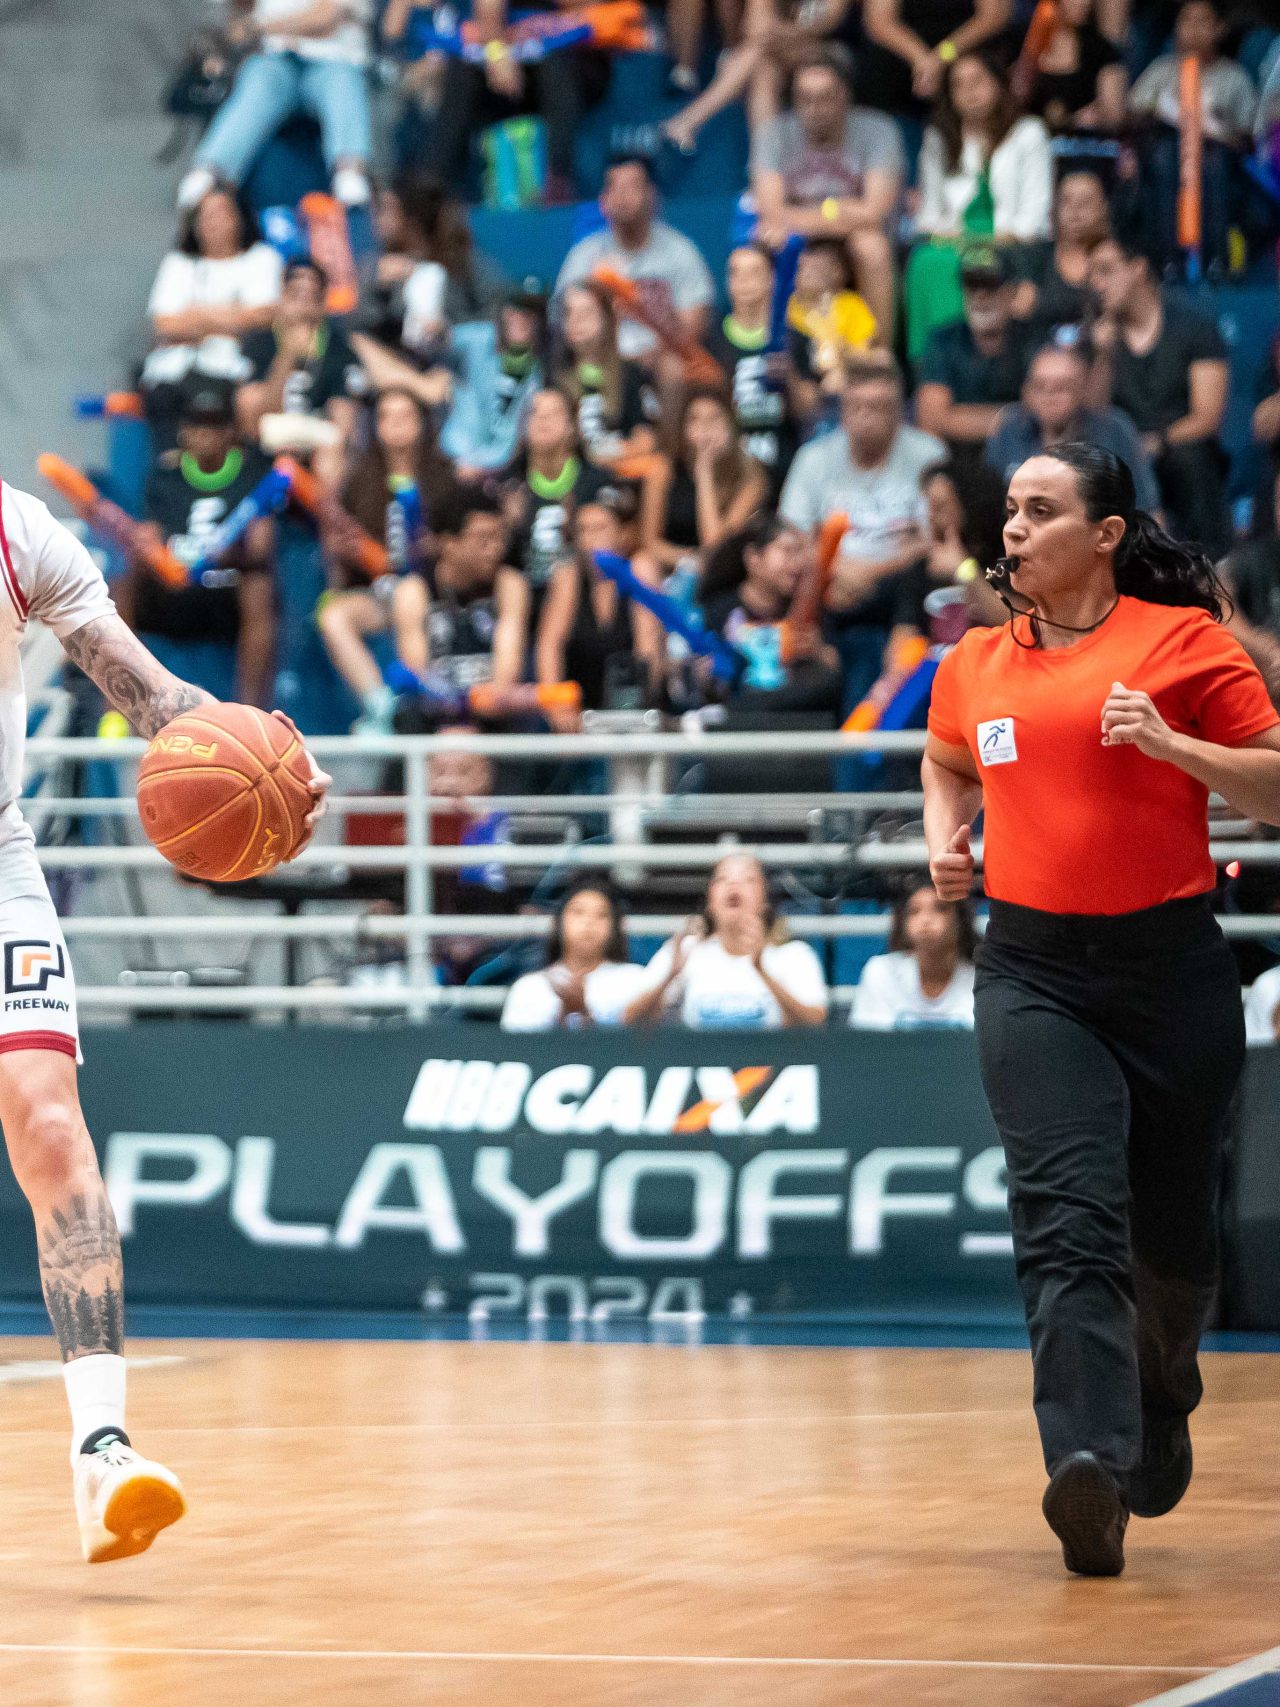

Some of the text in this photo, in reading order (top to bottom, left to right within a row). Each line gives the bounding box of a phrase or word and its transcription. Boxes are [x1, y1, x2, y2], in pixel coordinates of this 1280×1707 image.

[150, 734, 218, 759] PEN
[4, 997, 70, 1013] FREEWAY
[524, 1063, 821, 1136] CAIXA
[467, 1271, 706, 1321] 2024
